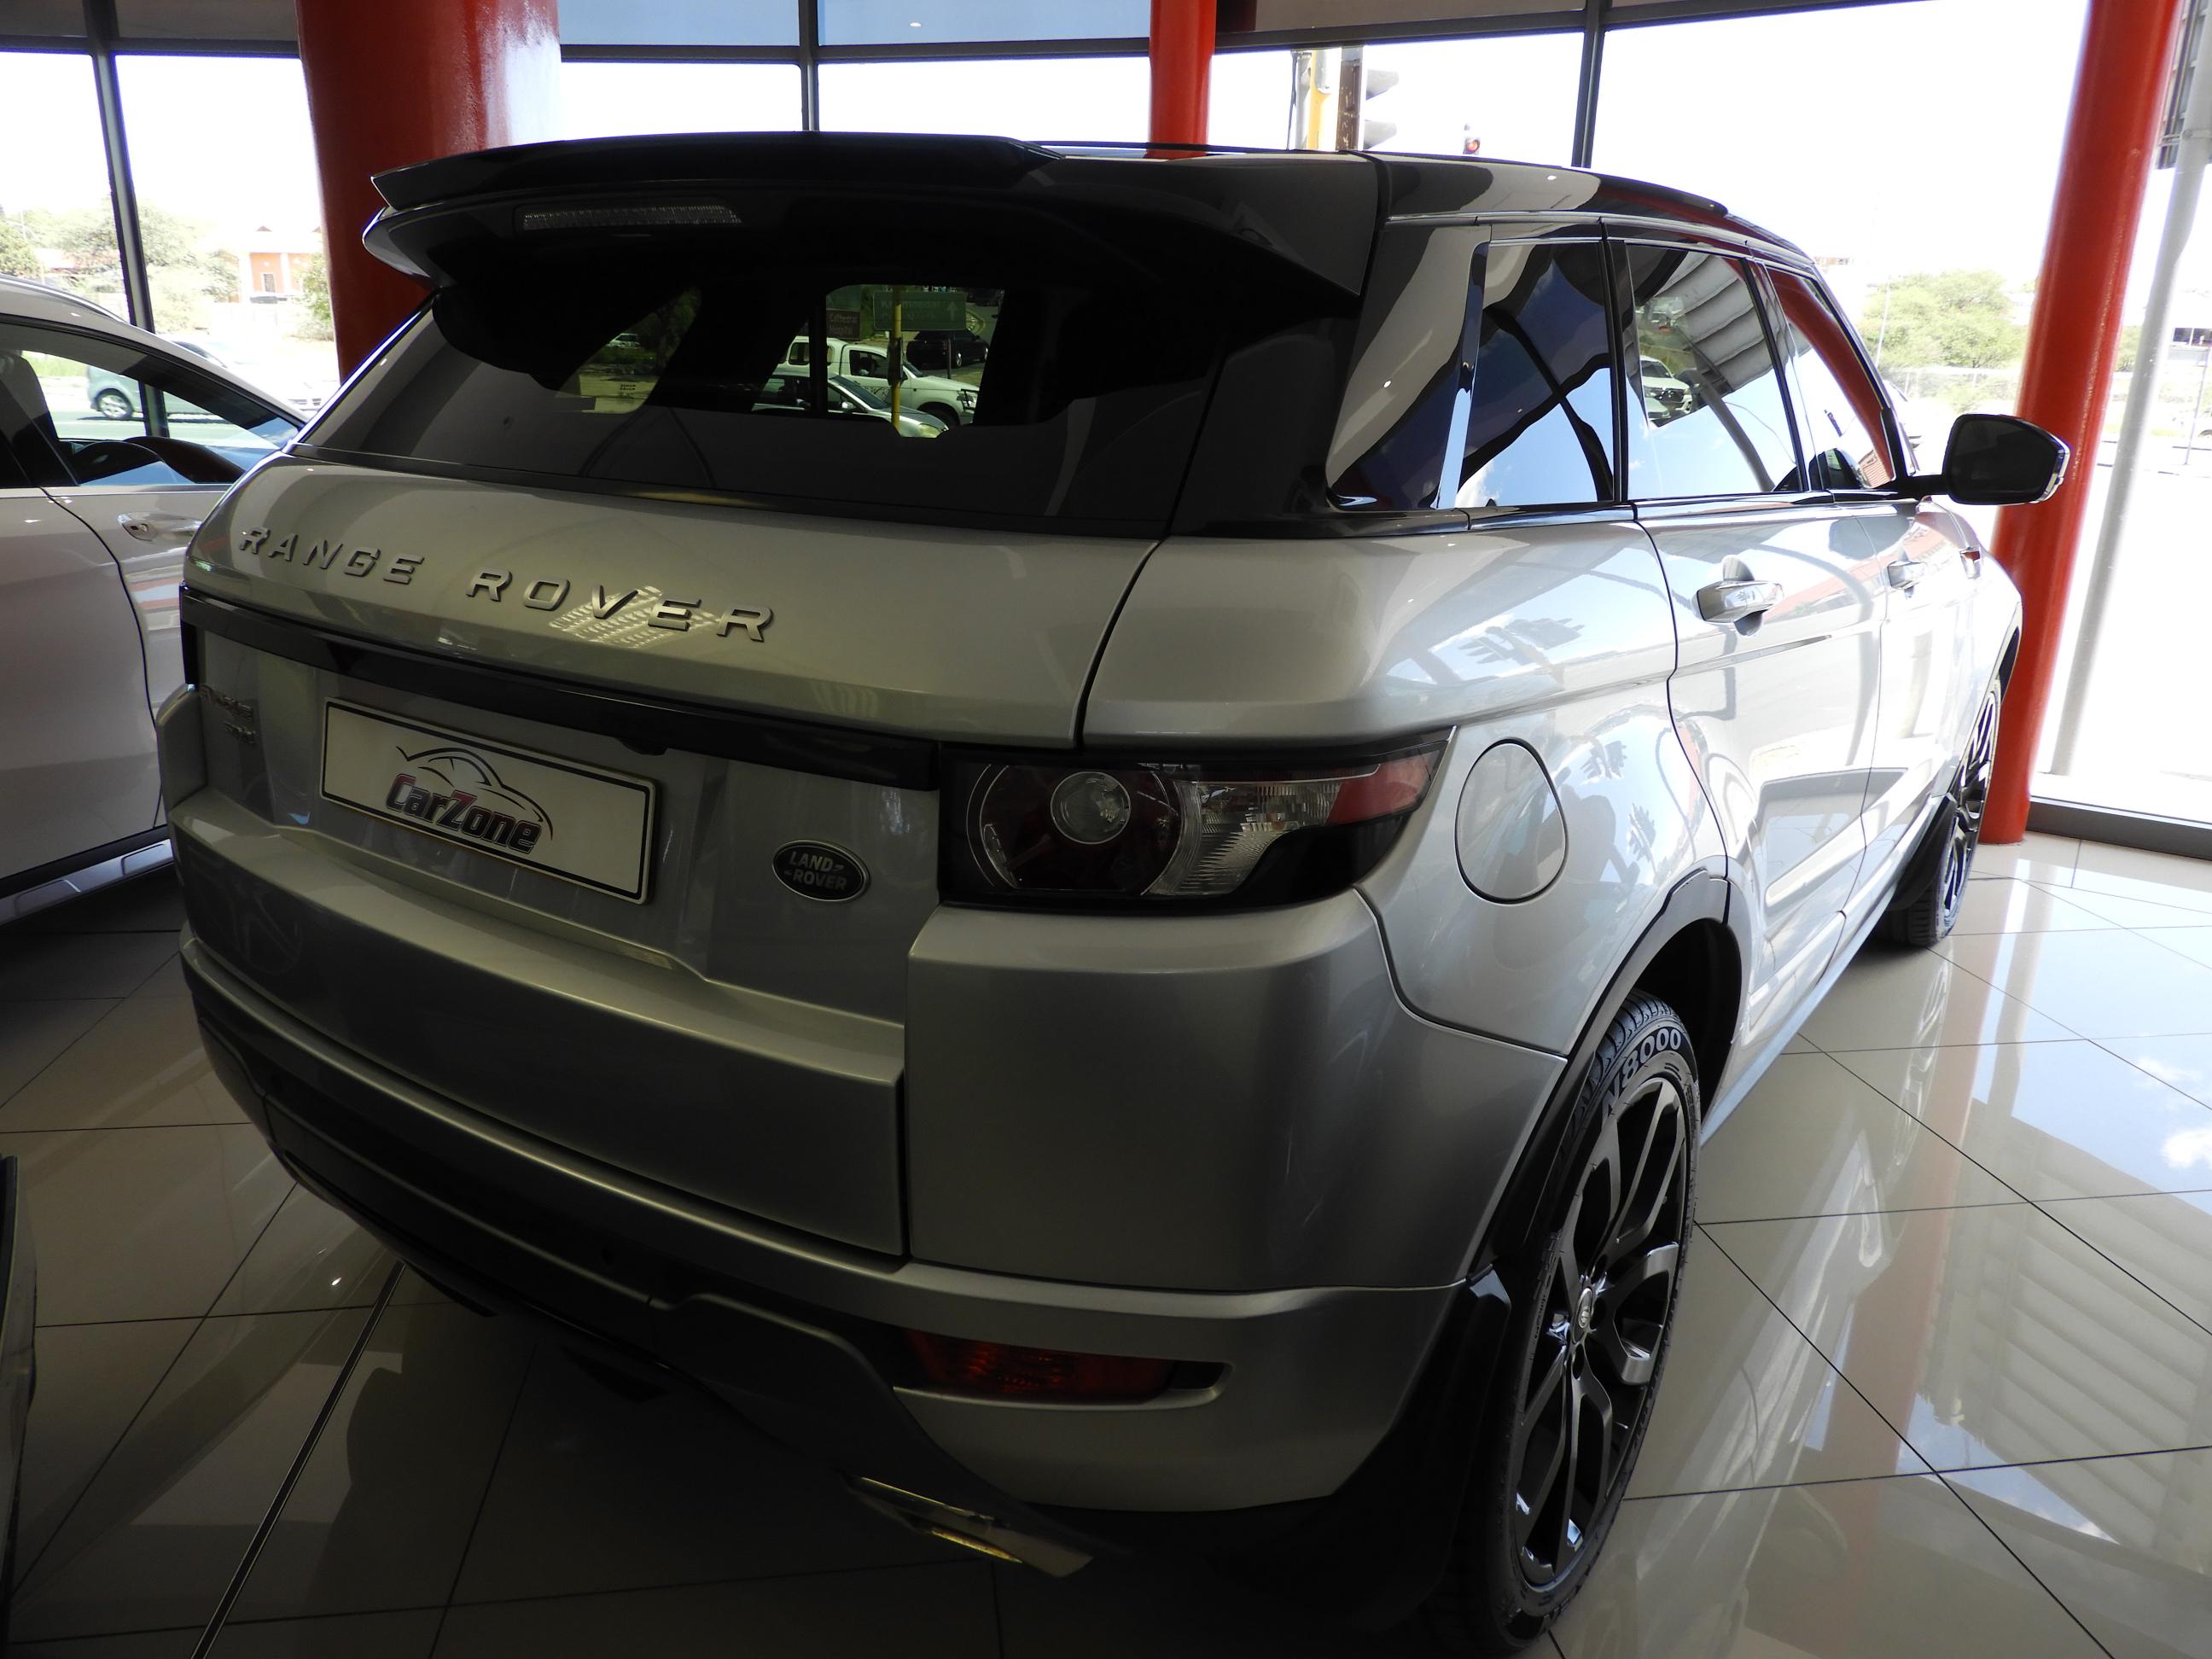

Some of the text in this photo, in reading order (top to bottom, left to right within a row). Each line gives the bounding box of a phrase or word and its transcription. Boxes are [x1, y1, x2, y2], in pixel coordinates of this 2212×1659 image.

[239, 526, 775, 643] RANGE ROVER
[386, 772, 543, 855] CarZone
[789, 851, 834, 872] LAND
[792, 868, 847, 891] ROVER
[1602, 1027, 1681, 1118] N8000
